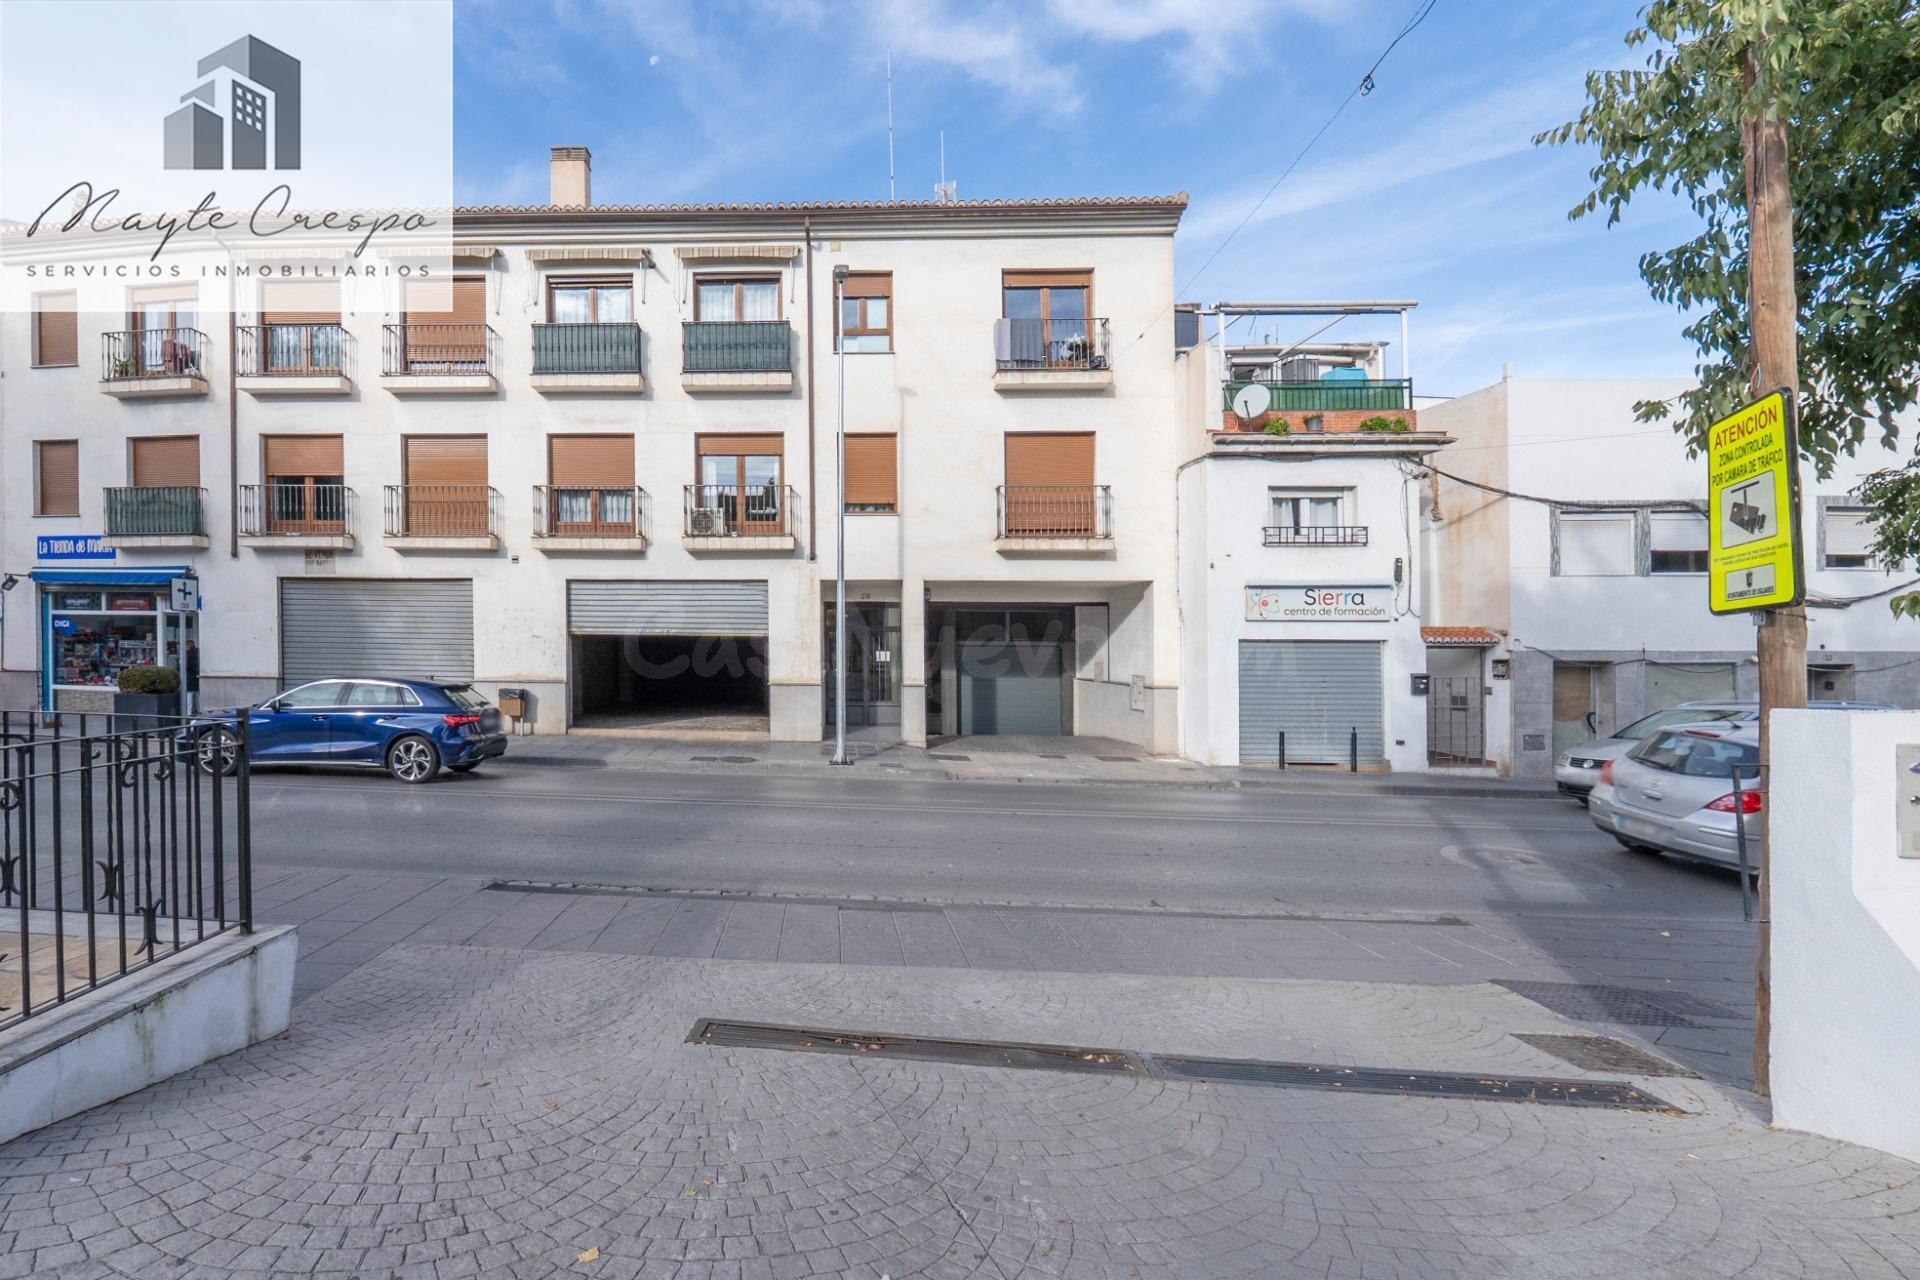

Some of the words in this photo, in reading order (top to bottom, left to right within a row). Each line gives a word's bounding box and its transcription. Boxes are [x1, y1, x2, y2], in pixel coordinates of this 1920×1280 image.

[1714, 404, 1778, 450] ATENCIÓN
[1719, 450, 1734, 467] ZONA
[1735, 432, 1774, 460] CONTROLADA
[1712, 472, 1724, 488] POR
[1748, 459, 1757, 474] DE
[39, 541, 48, 554] La
[76, 539, 85, 553] de
[1304, 588, 1365, 606] Sierra
[1284, 607, 1317, 616] centro
[1318, 607, 1332, 616] de
[1333, 606, 1386, 616] formación
[55, 620, 70, 628] DIGI
